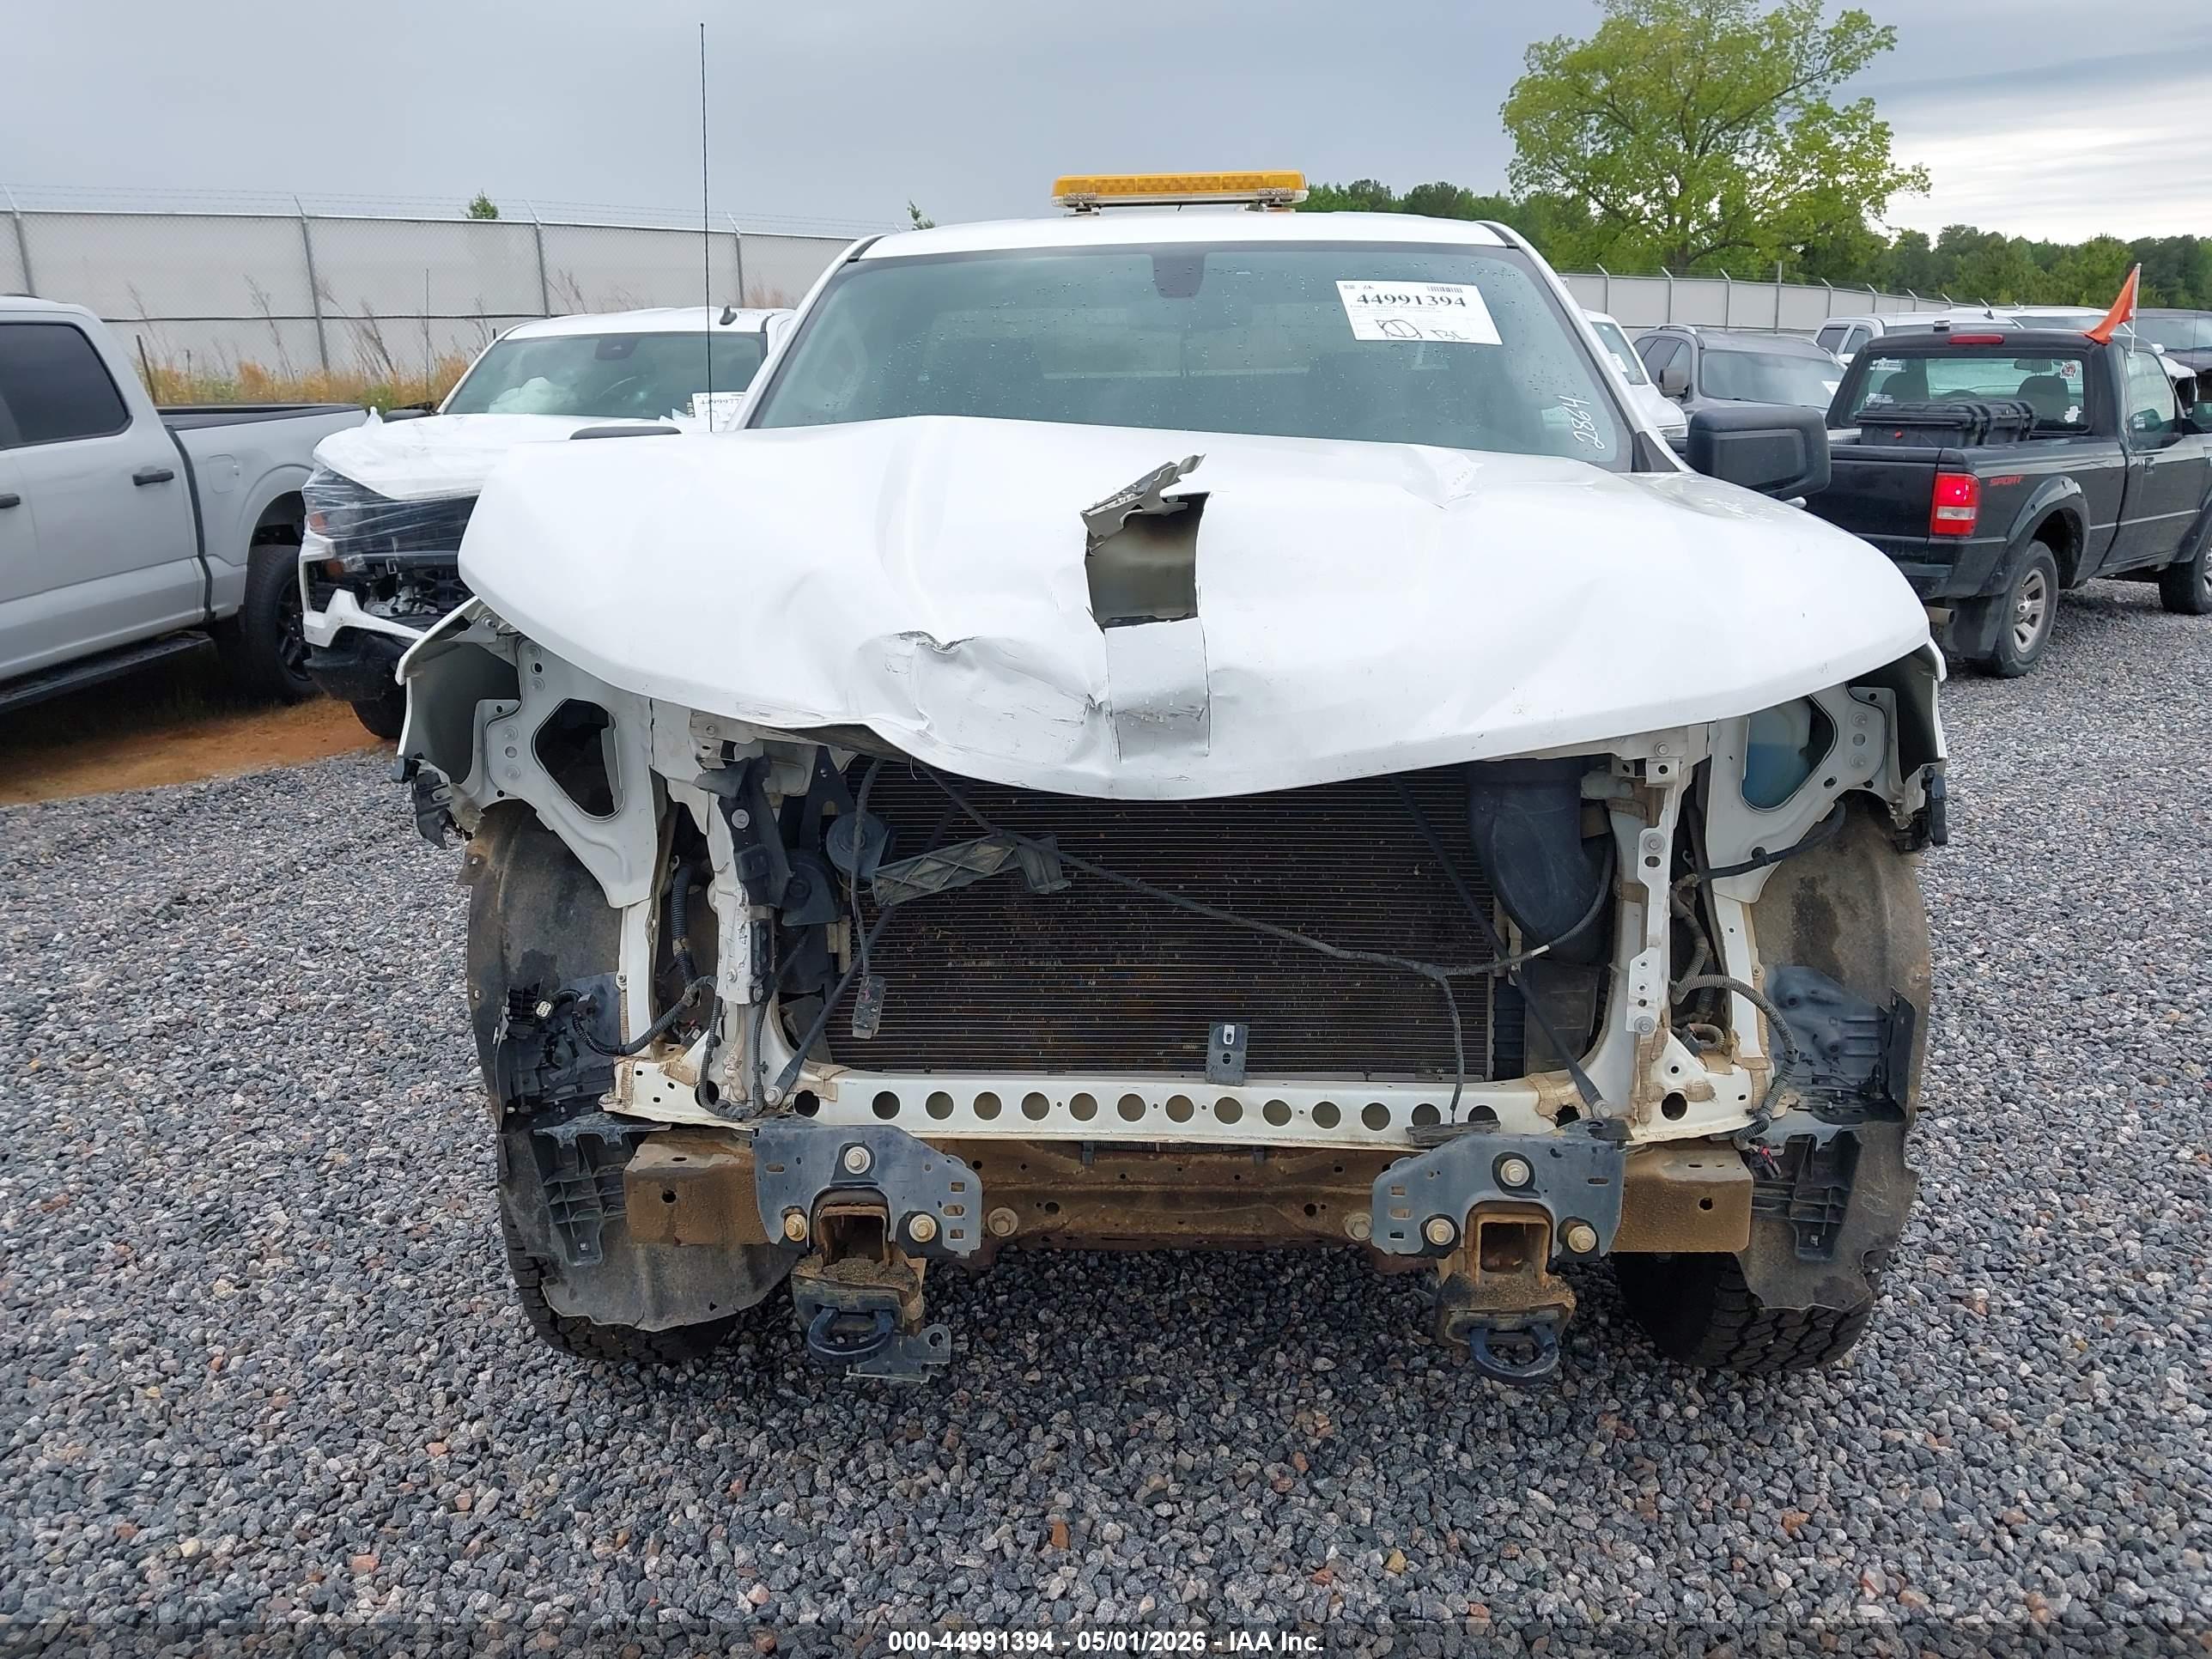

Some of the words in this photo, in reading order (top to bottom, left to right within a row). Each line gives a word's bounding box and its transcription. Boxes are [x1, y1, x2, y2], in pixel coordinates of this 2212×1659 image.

[1357, 293, 1467, 308] 44991394
[1559, 395, 1606, 450] 2864
[1990, 476, 2026, 487] SPORT
